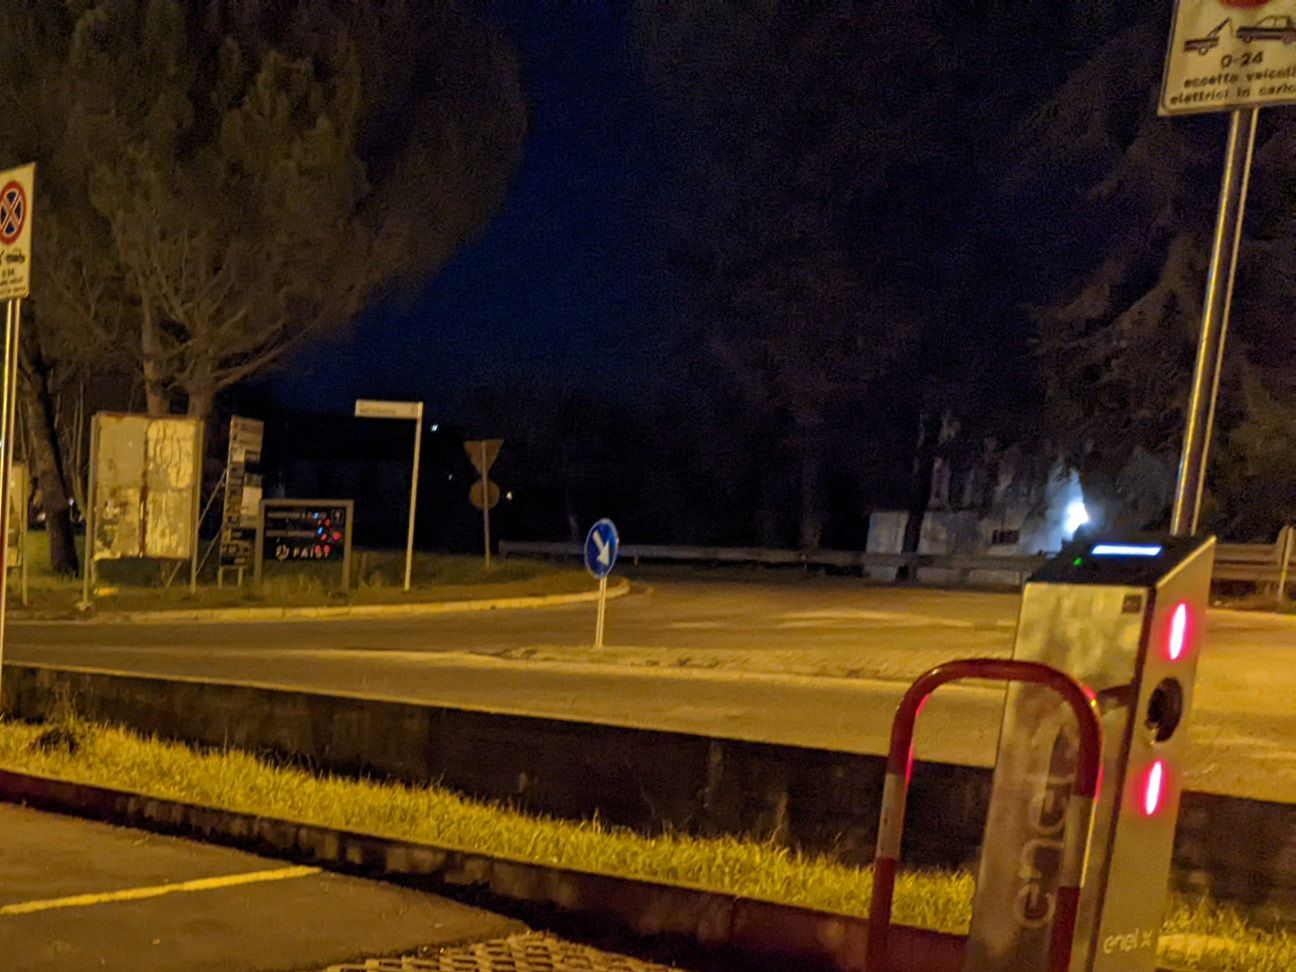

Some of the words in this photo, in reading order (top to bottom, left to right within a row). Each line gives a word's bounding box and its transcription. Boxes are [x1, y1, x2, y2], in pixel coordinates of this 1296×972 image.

[1170, 88, 1230, 105] elettrici
[1237, 87, 1251, 97] in
[1104, 927, 1139, 954] enel
